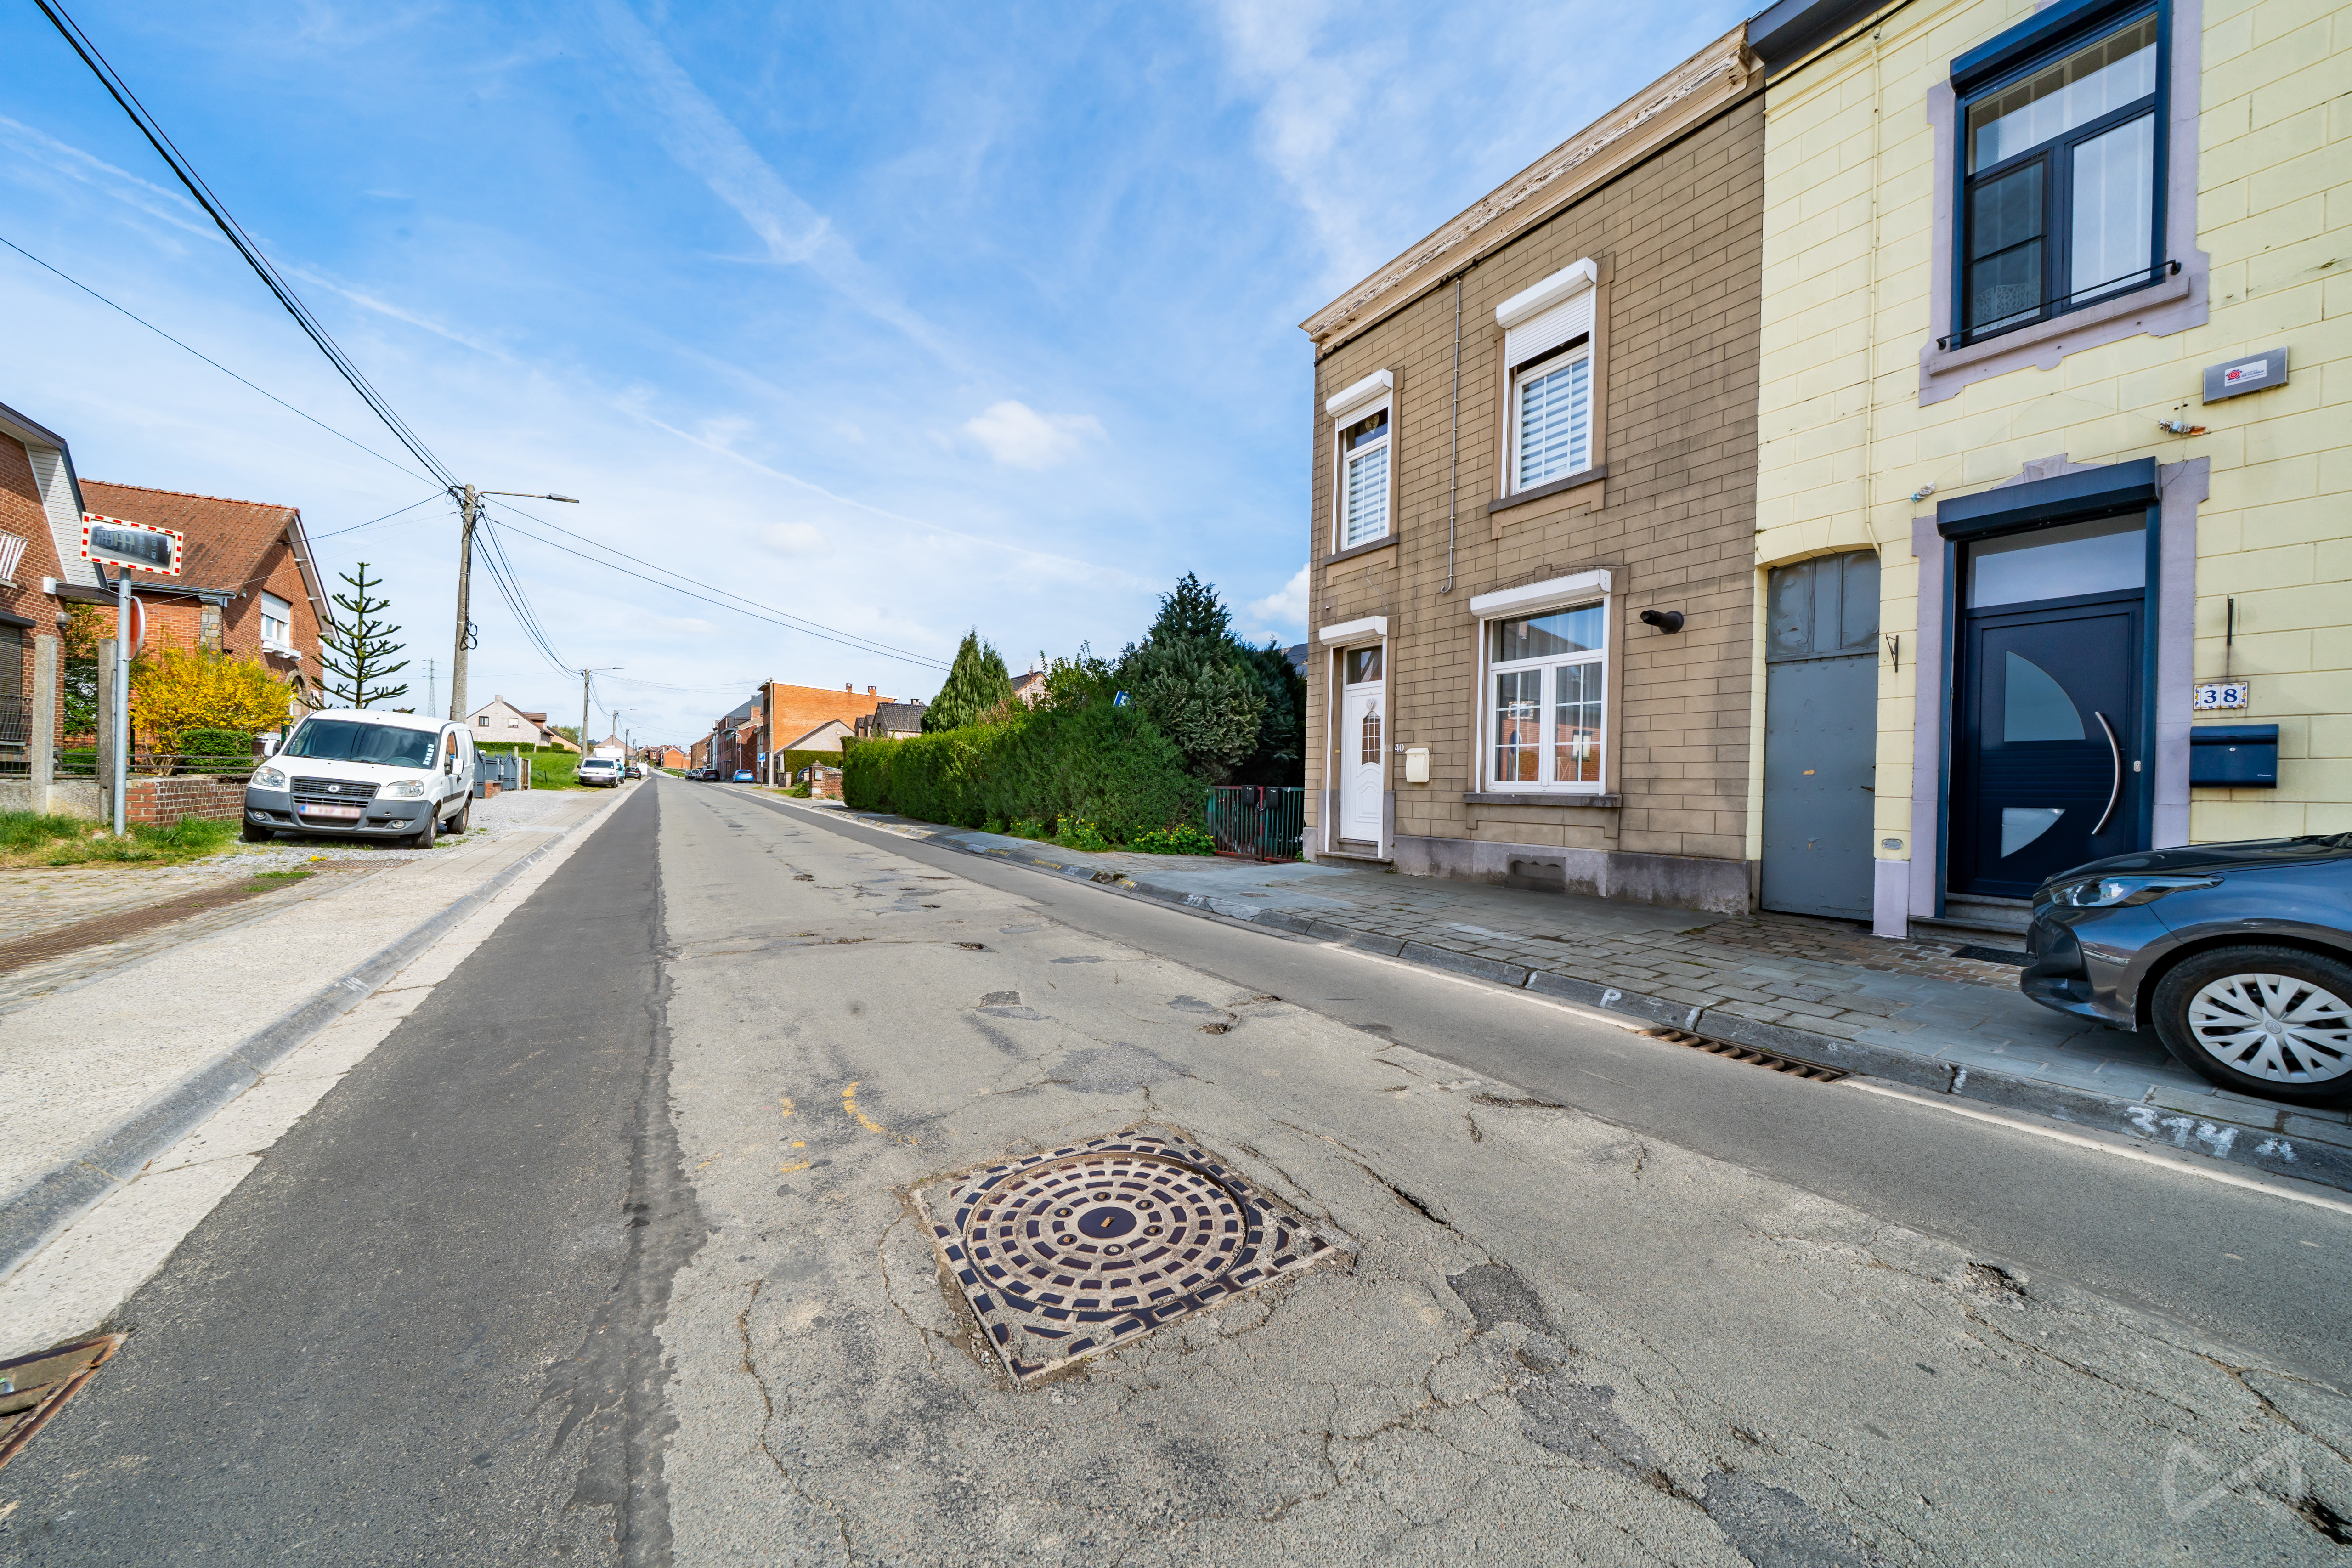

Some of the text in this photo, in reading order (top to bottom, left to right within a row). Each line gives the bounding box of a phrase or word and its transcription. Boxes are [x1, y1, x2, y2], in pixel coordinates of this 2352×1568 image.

[2204, 688, 2238, 704] 38
[1395, 743, 1405, 752] 40
[1184, 894, 1203, 907] 373
[1600, 988, 1622, 1008] P
